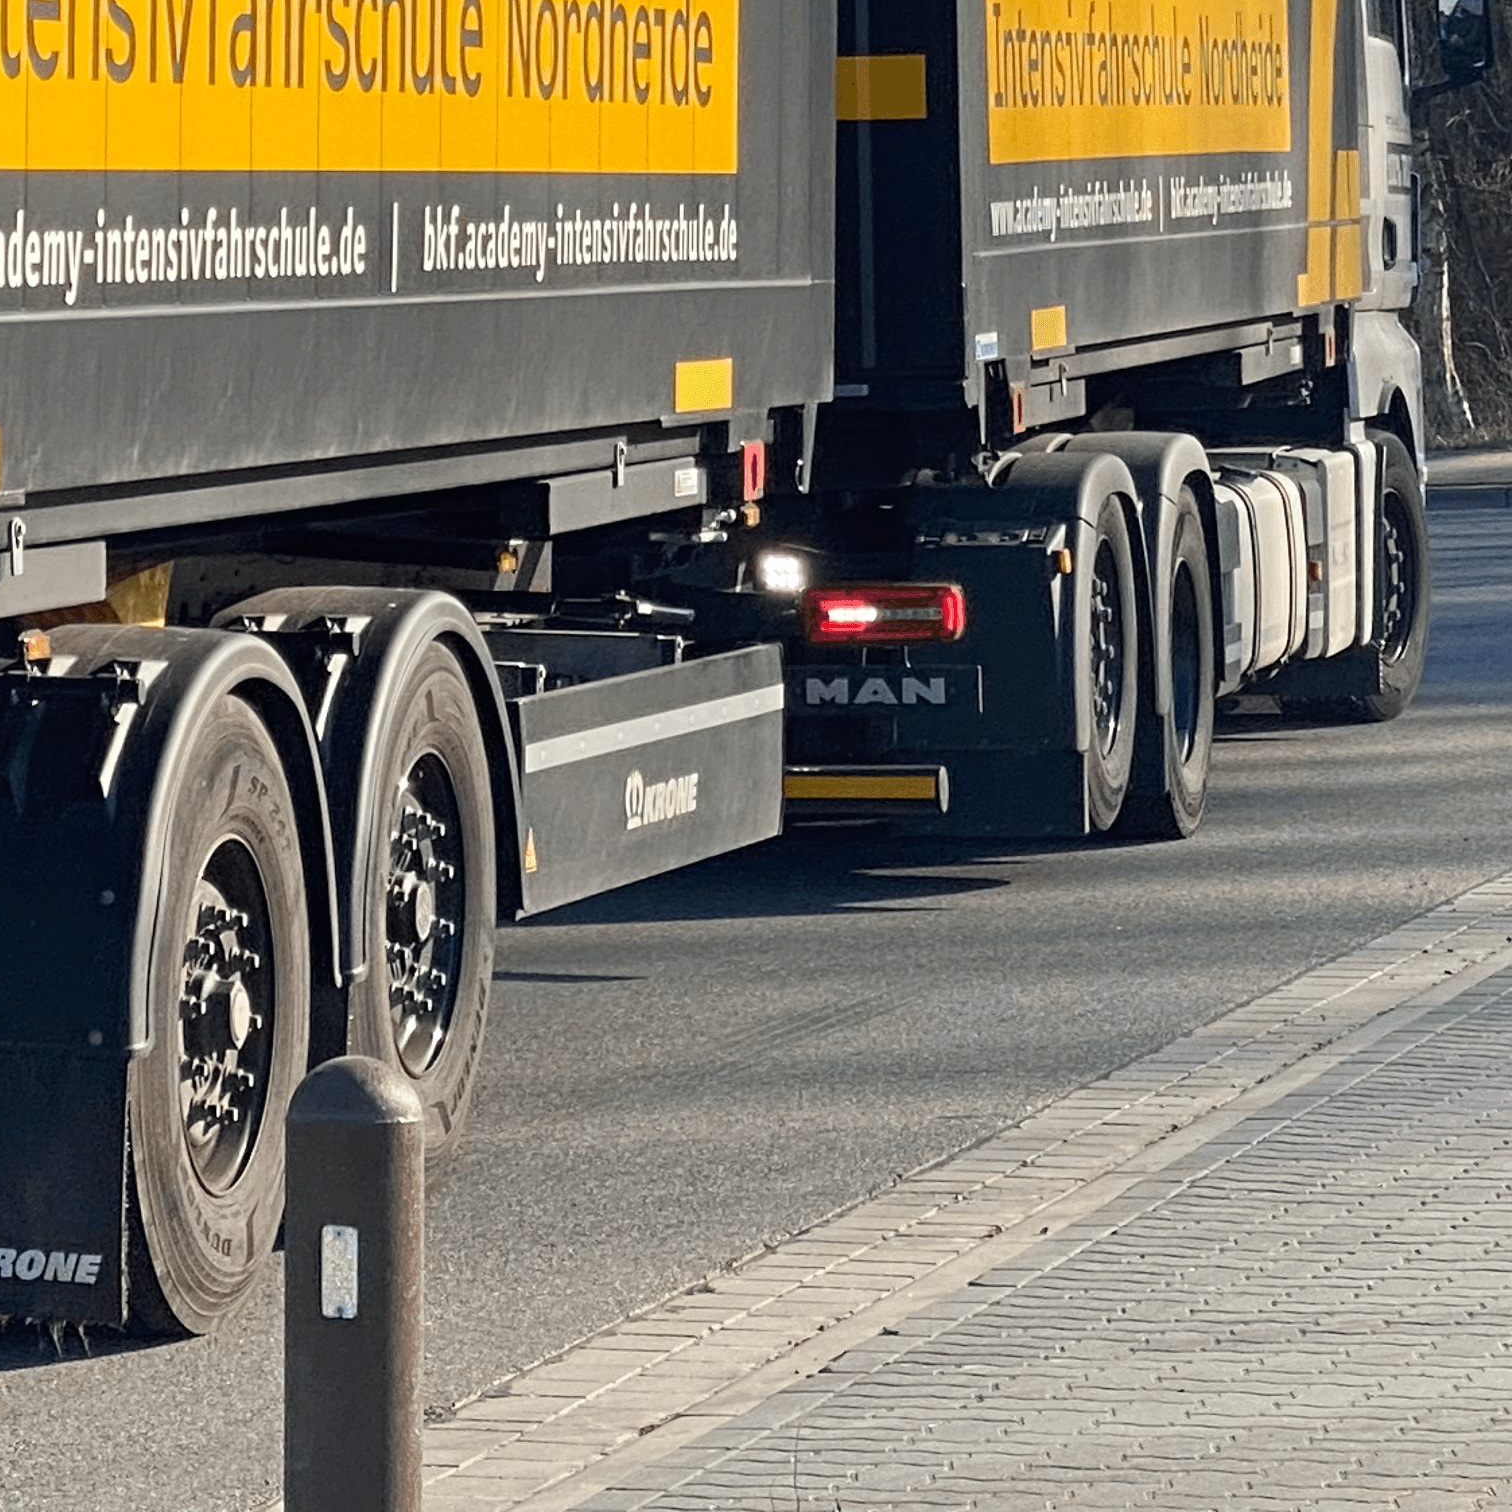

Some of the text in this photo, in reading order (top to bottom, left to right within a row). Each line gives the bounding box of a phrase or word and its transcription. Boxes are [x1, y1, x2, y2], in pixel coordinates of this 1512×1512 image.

[1199, 11, 1283, 107] Nordheide
[423, 203, 738, 283] bkf.academy-intensivfahrschule.de
[805, 677, 946, 705] MAN
[643, 772, 699, 825] KRONE
